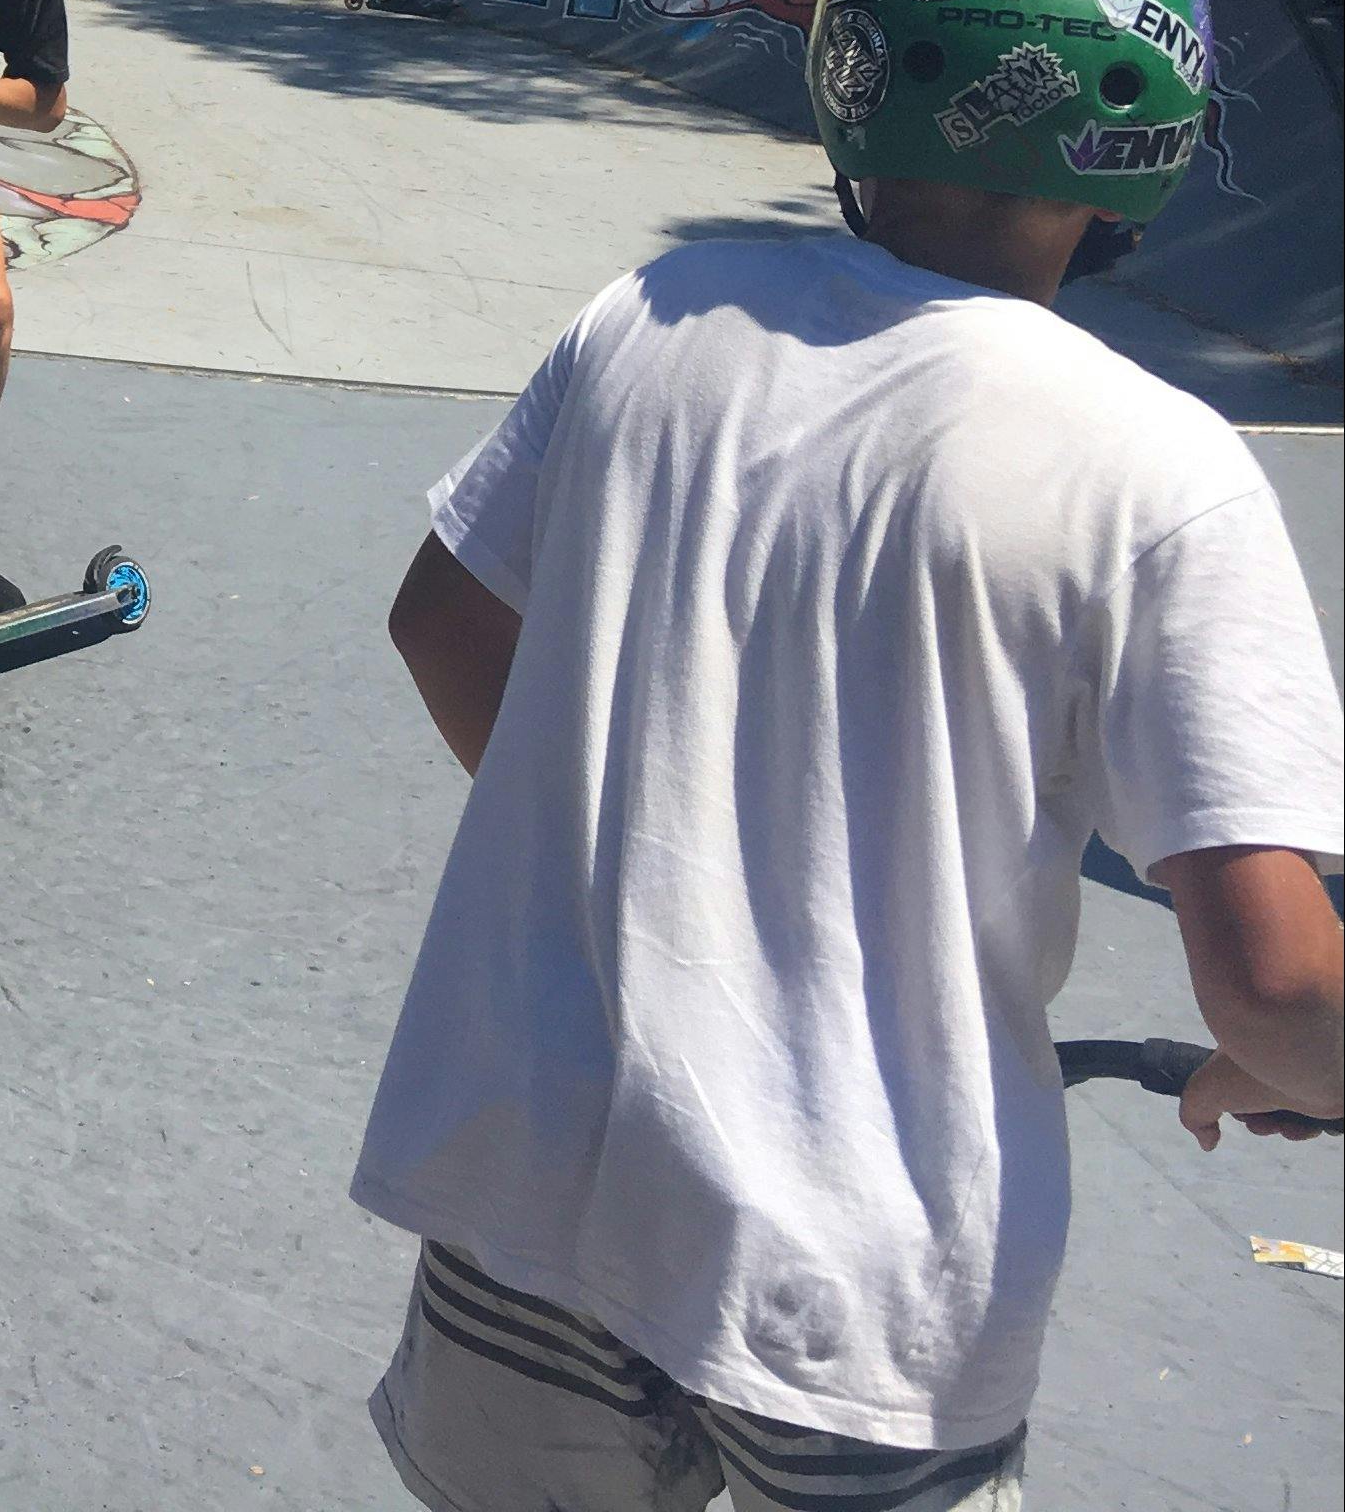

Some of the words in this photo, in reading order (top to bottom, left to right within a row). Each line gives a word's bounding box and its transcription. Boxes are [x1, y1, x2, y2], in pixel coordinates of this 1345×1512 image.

[937, 6, 1117, 42] PRO-TEC
[1132, 0, 1207, 75] ENVY
[945, 56, 1047, 142] SLAM
